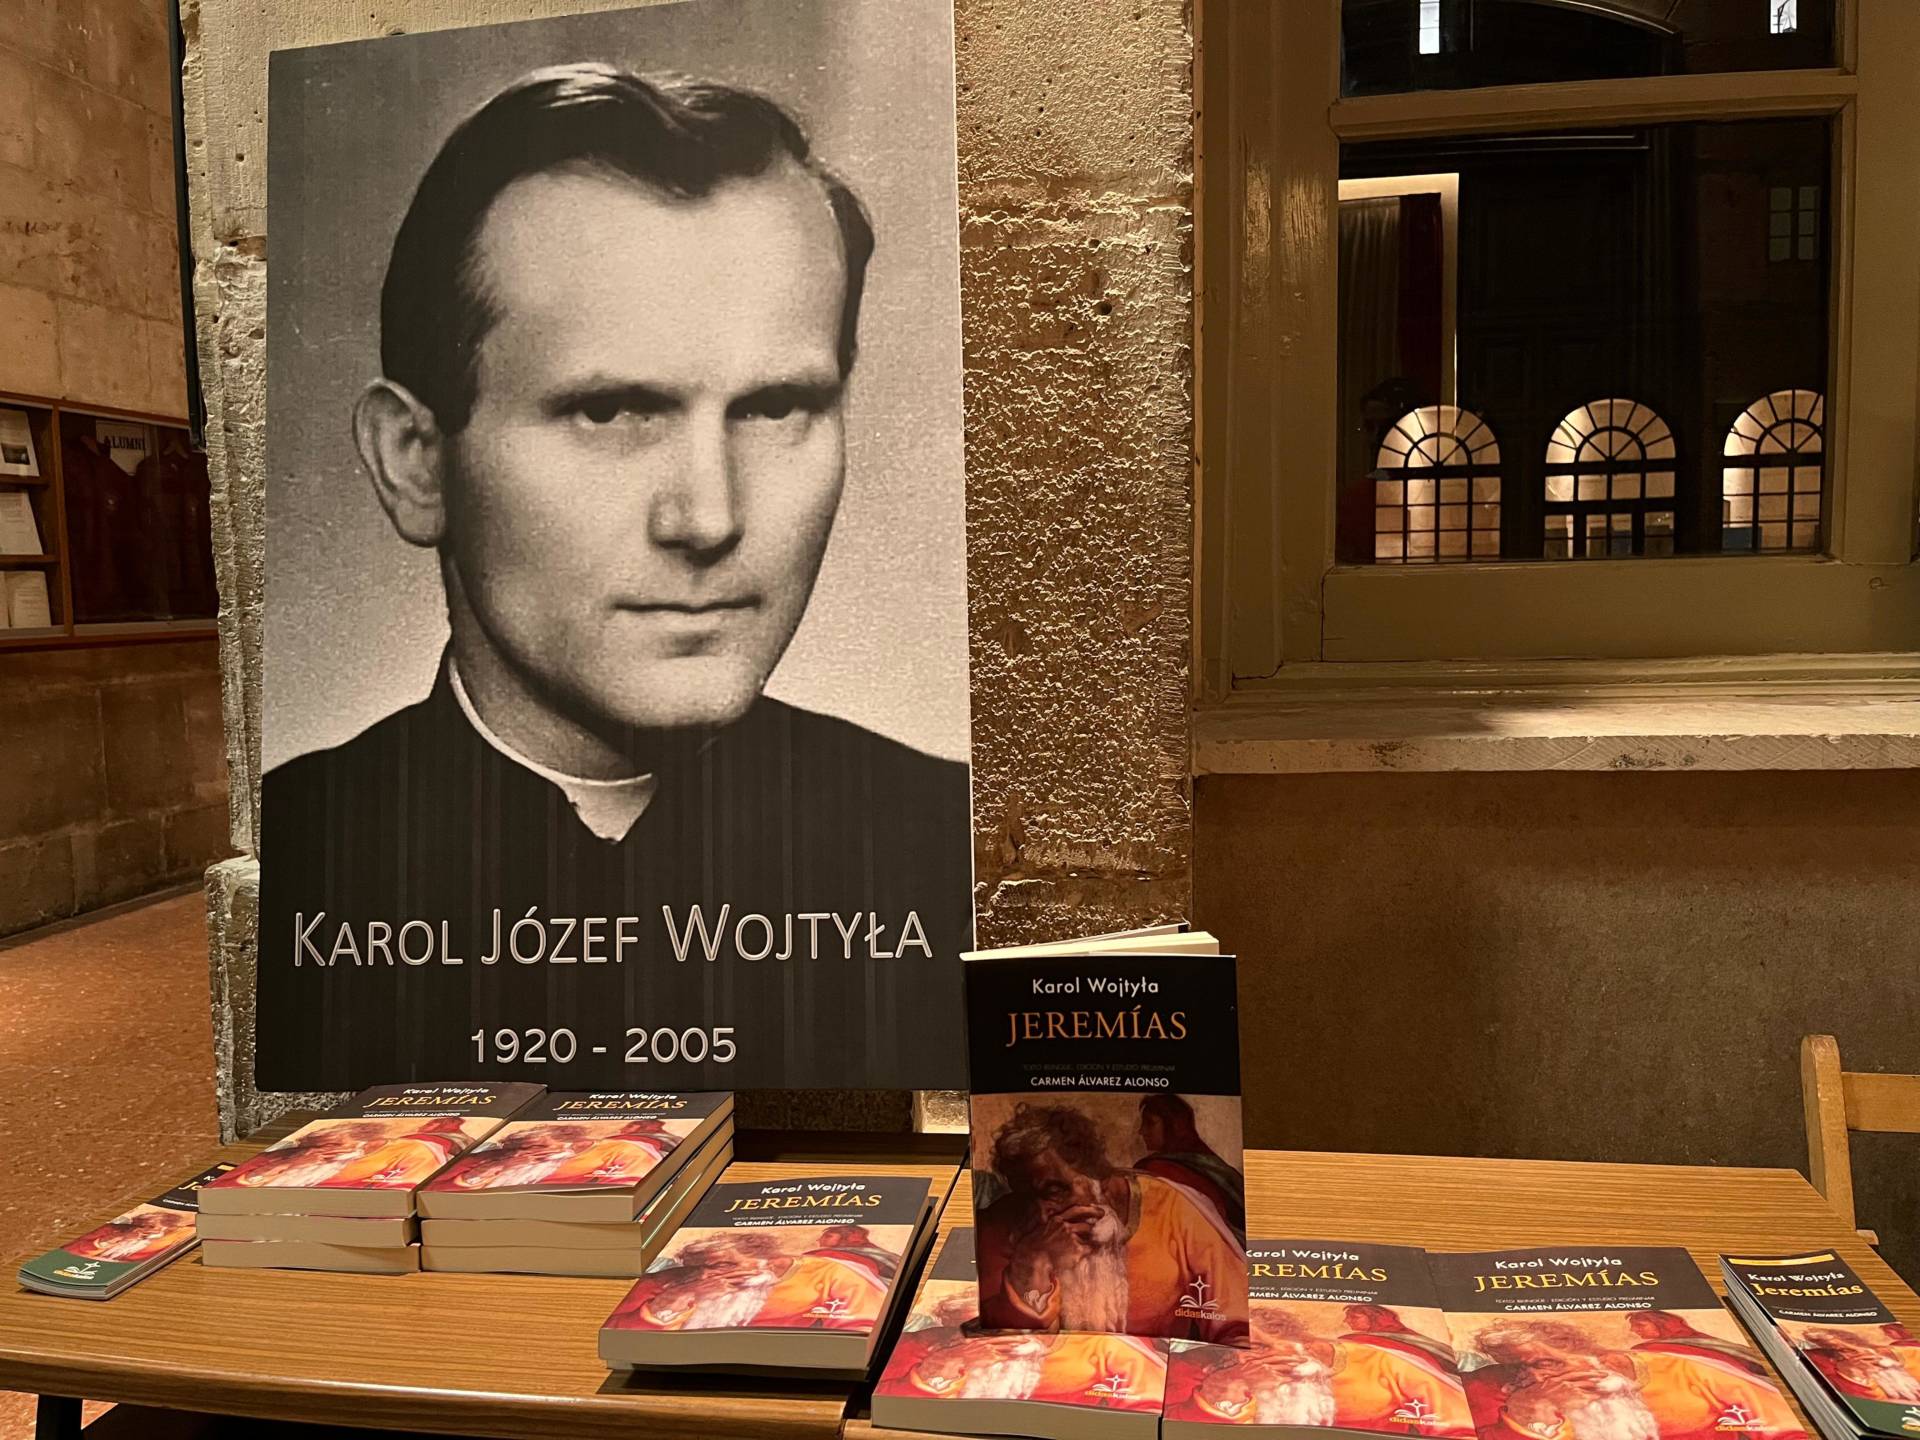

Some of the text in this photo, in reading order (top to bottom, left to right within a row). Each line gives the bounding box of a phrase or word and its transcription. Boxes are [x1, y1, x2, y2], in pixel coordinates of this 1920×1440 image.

[294, 903, 932, 967] KAROL JÓZEF WOJTYŁA
[1032, 976, 1159, 998] Karol Wojtyła
[1005, 1004, 1187, 1048] JEREMÍAS
[470, 1026, 577, 1064] 1920
[624, 1026, 737, 1063] 2005
[1031, 1073, 1169, 1088] CARMEN ÁLVAREZ ALONSO
[362, 1094, 497, 1108] JEREMÍAS
[552, 1099, 688, 1111] JEREMÍAS
[761, 1182, 866, 1194] Karol Wojtyła
[724, 1192, 882, 1212] JEREMÍAS
[775, 1217, 813, 1225] ÁLVAREZ
[1292, 1250, 1360, 1261] Wojtyła
[1495, 1256, 1622, 1269] Karol Wojtyła
[1247, 1263, 1388, 1282] REMÍAS
[1747, 1273, 1787, 1282] Karol
[1473, 1269, 1659, 1293] JEREMÍAS
[1282, 1291, 1325, 1300] ÁLVAREZ
[1327, 1294, 1373, 1302] ALONSO
[1750, 1282, 1864, 1297] Jeremías
[1504, 1304, 1552, 1312] CARMEN
[1555, 1302, 1602, 1310] ÁLVAREZ
[1175, 1308, 1227, 1321] didaskalos
